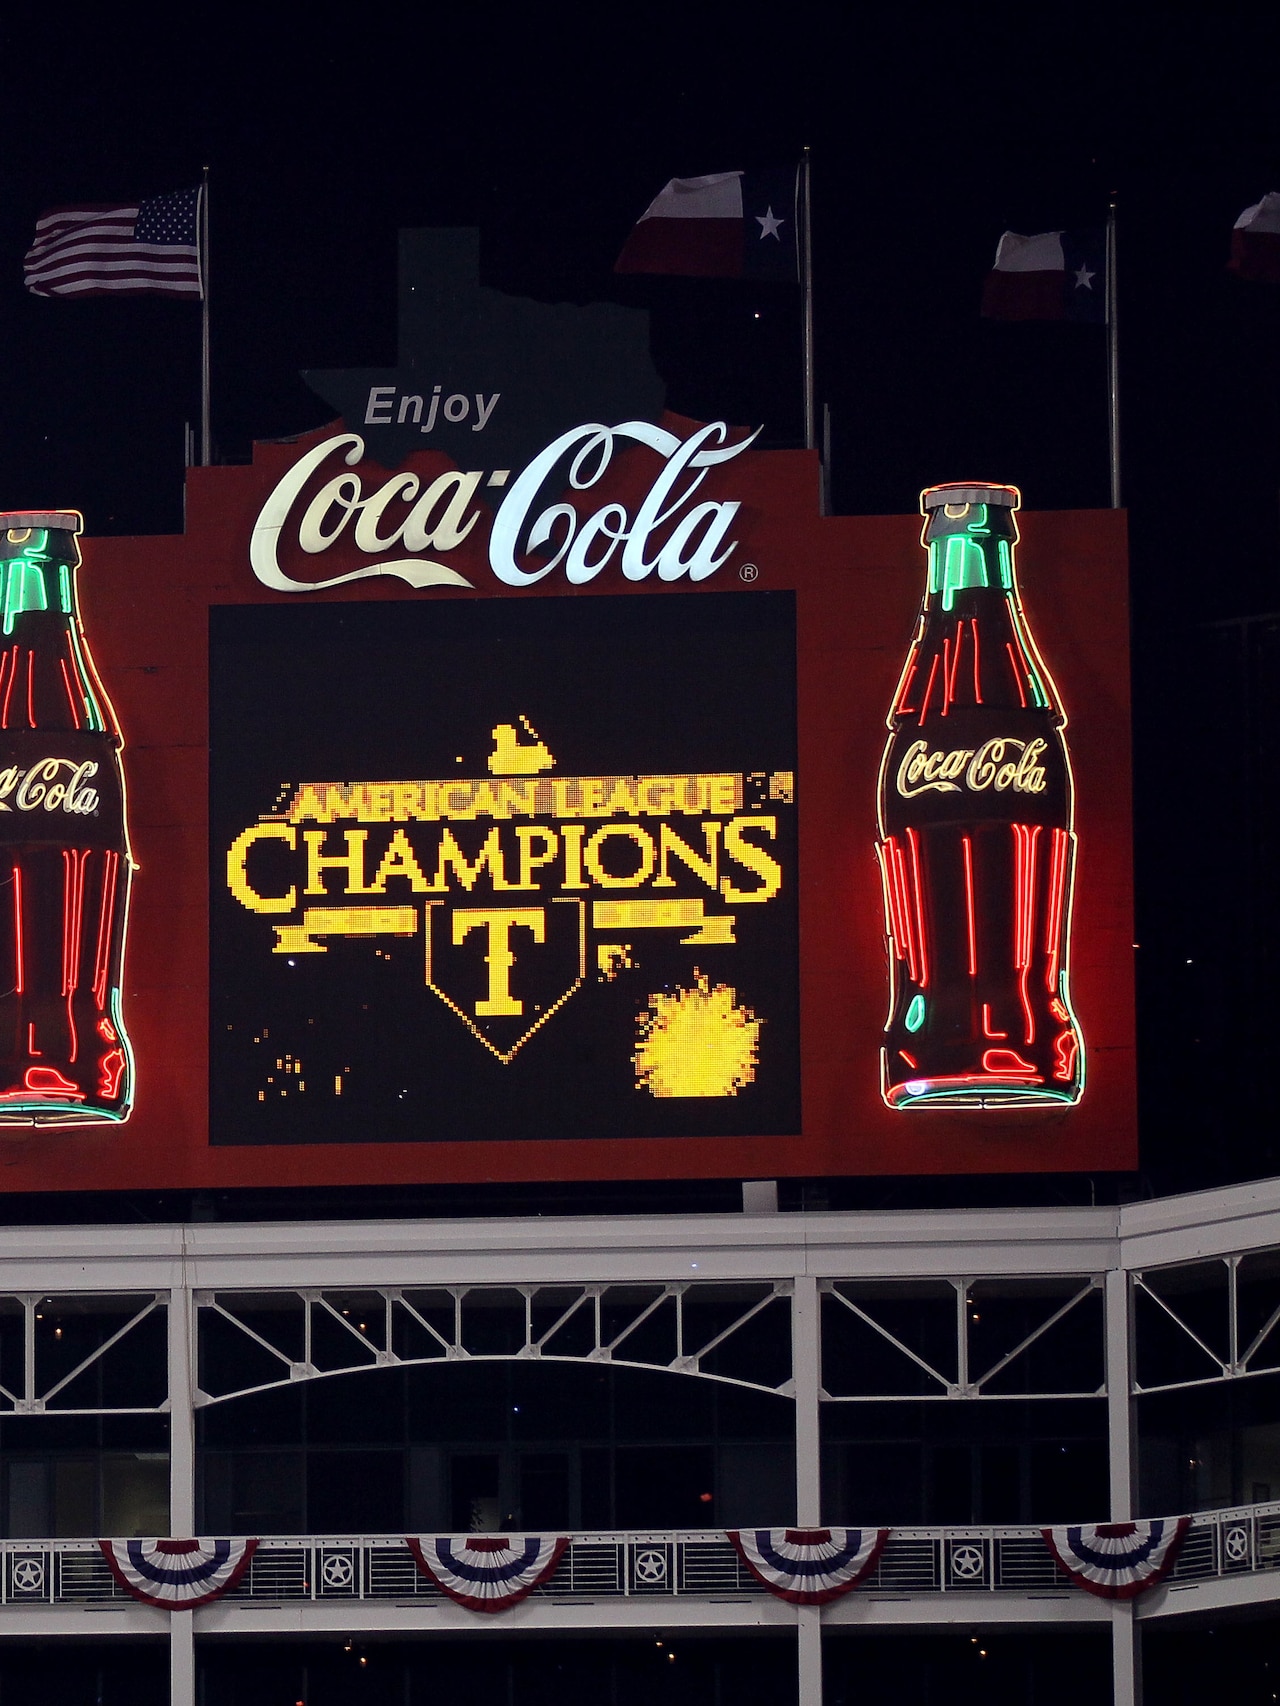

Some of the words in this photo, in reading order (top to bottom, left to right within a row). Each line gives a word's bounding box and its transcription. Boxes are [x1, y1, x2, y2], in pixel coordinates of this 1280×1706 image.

[363, 385, 501, 433] Enjoy
[291, 779, 539, 823] AMERICAN
[551, 775, 738, 818] LEAGUE
[226, 816, 782, 913] CHAMPIONS
[452, 906, 546, 1016] T
